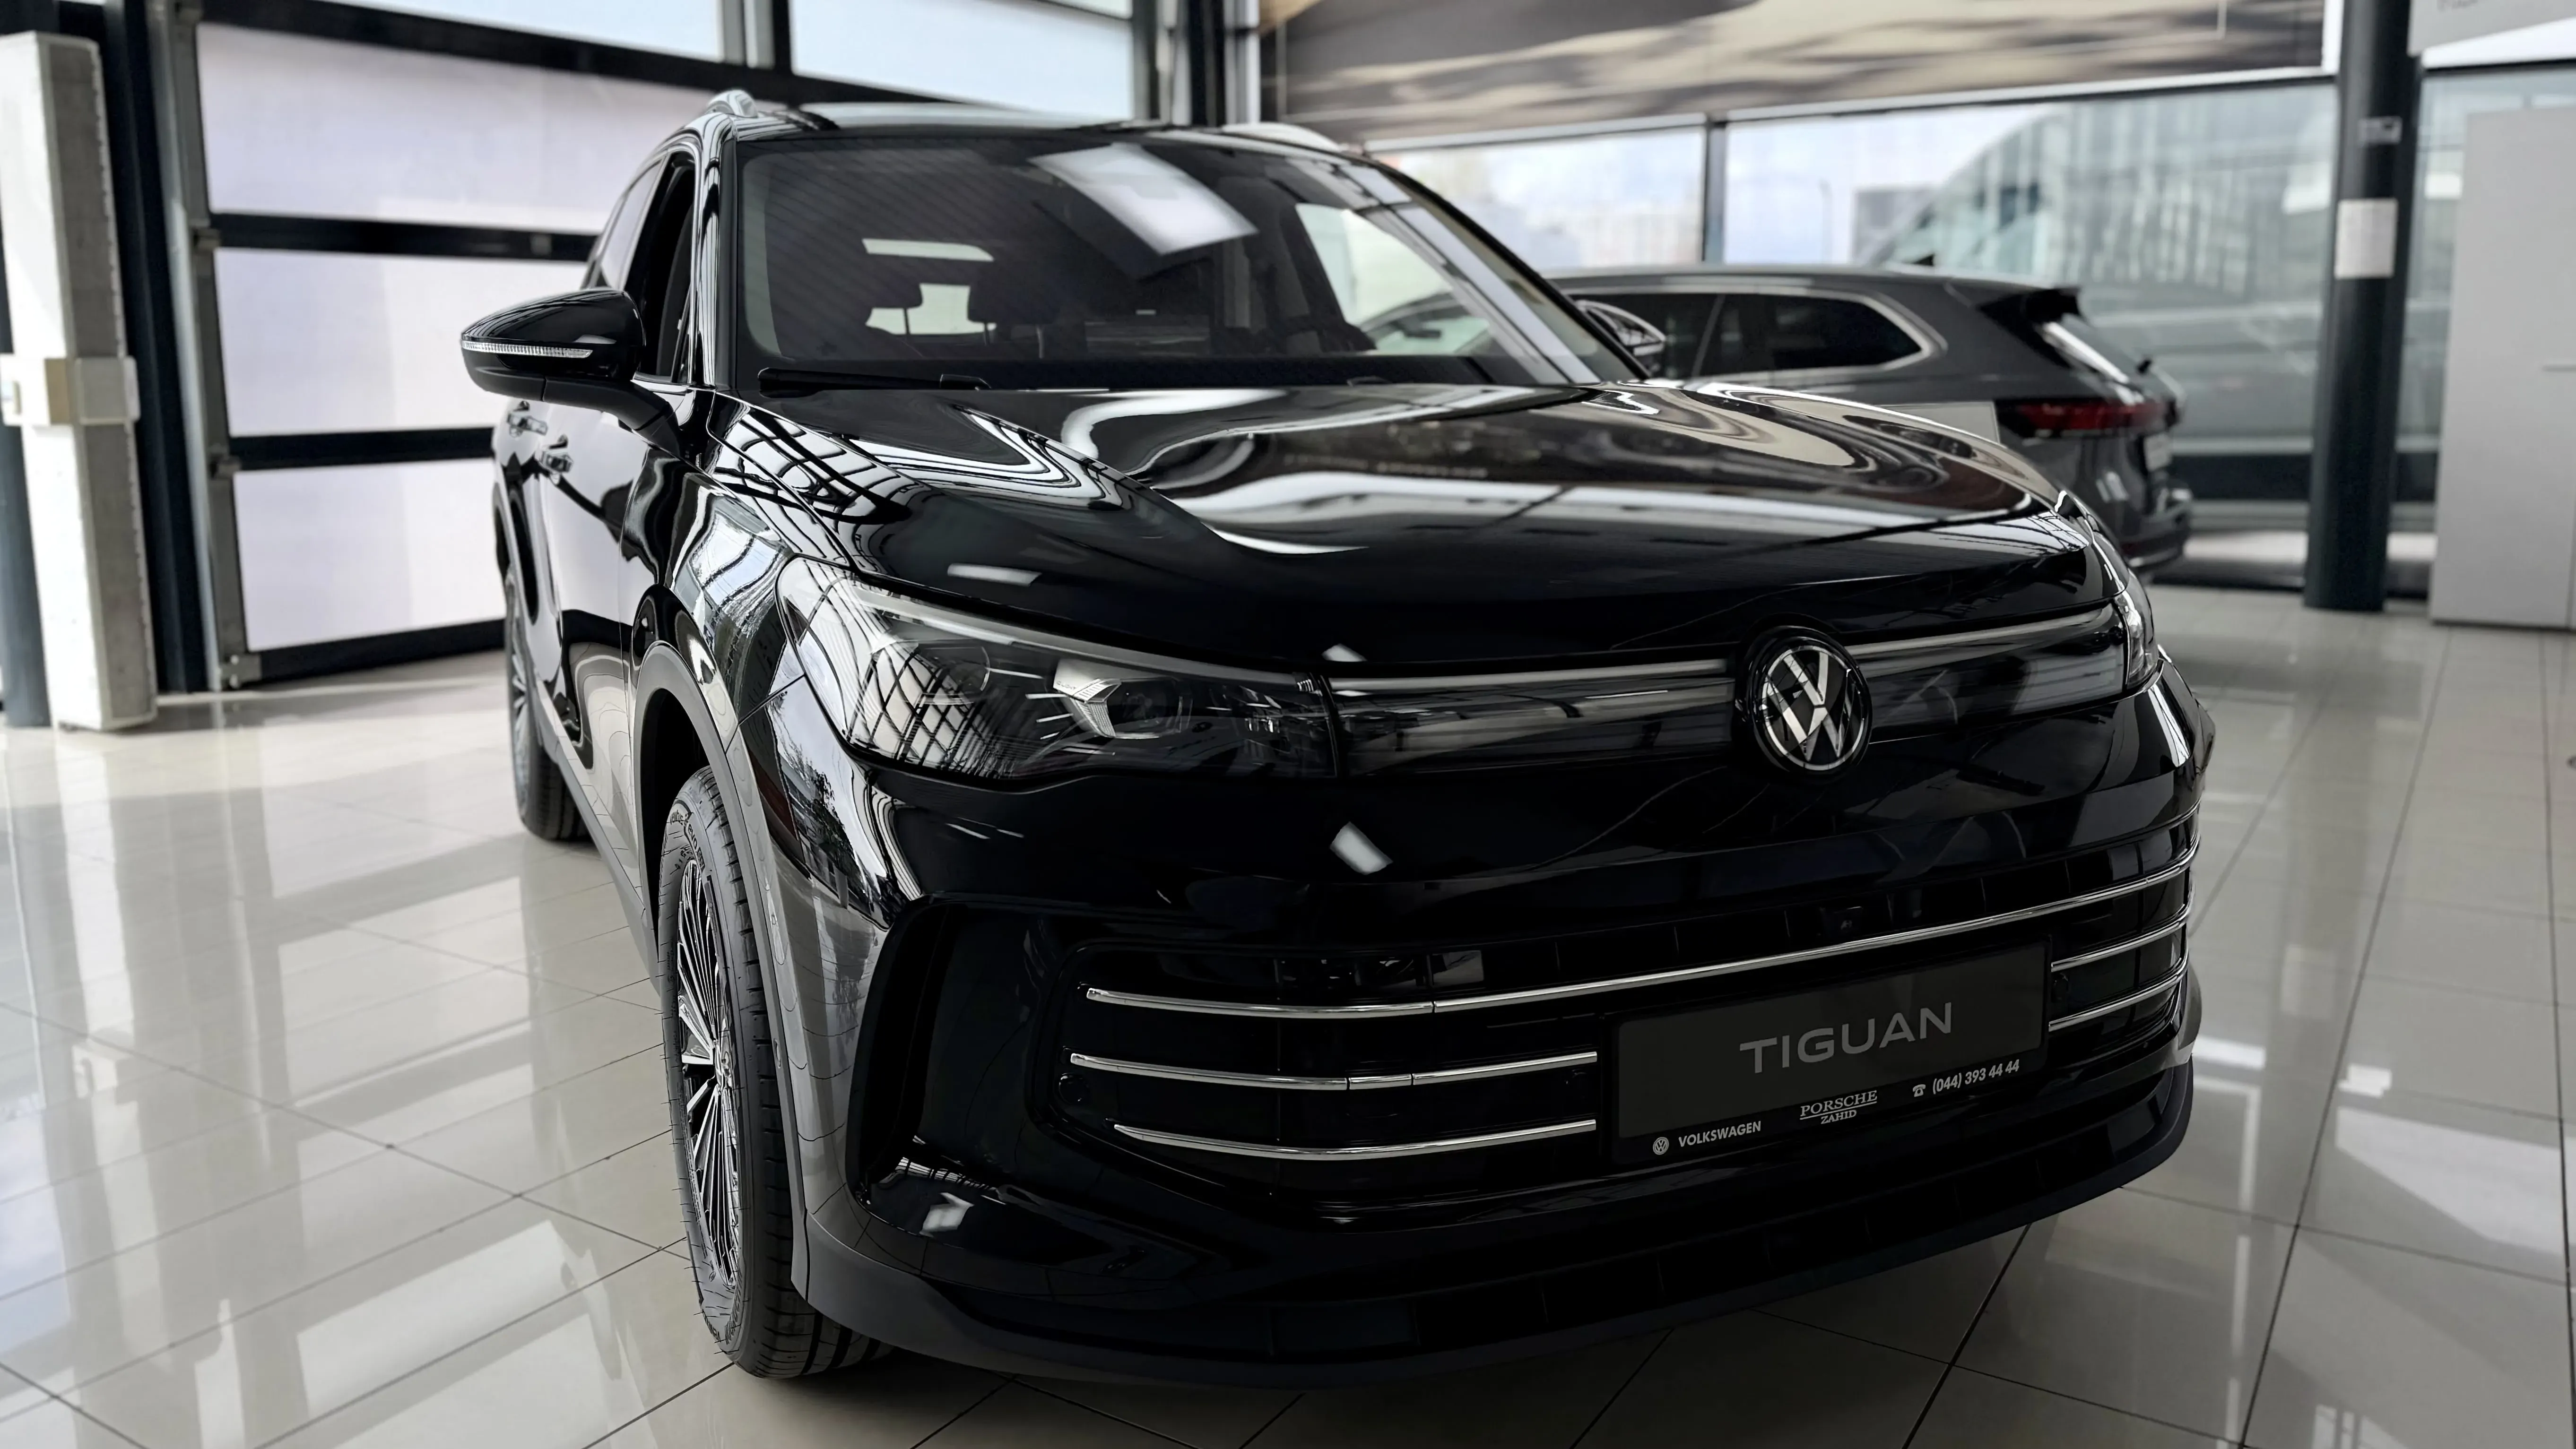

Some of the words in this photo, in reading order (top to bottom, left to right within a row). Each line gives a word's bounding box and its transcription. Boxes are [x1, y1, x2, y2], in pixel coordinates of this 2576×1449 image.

[1740, 1002, 1952, 1073] TIGUAN
[1933, 1073, 1962, 1095] (044)
[1965, 1068, 1986, 1085] 393
[1988, 1063, 2003, 1078] 44
[2005, 1059, 2020, 1073] 44
[1800, 1090, 1877, 1117] PORSCHE
[1821, 1110, 1857, 1124] ZAHID
[1678, 1121, 1761, 1147] VOLKSWAGEN
